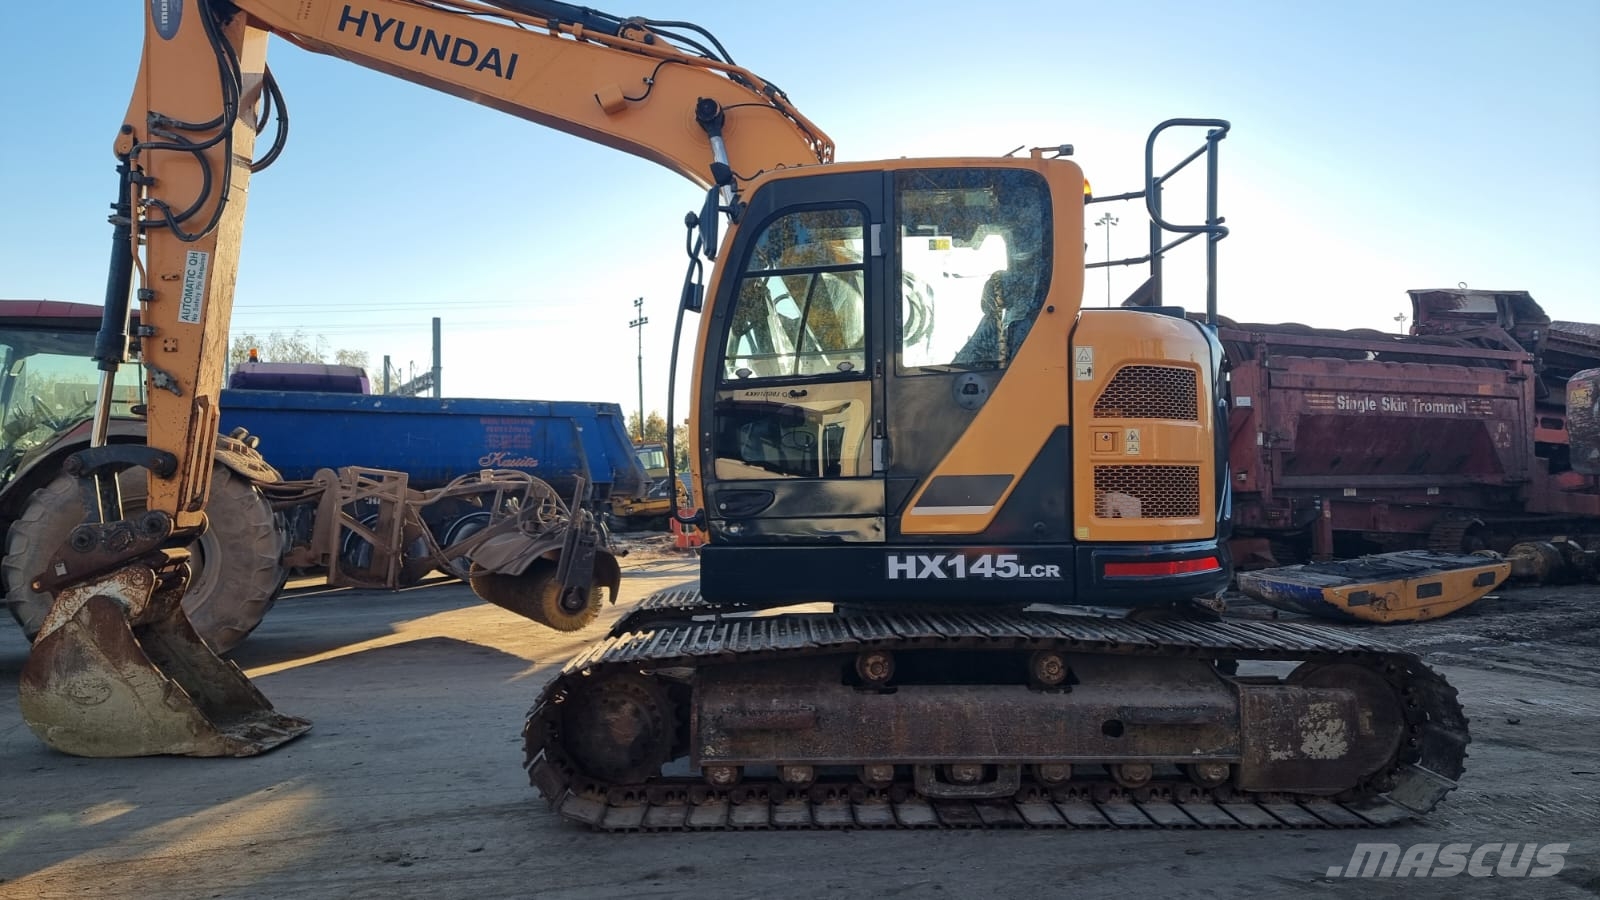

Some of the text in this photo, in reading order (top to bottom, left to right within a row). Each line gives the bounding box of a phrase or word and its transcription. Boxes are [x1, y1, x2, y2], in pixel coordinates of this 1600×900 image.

[337, 4, 519, 80] HYUNDAI
[198, 253, 206, 279] Required
[182, 252, 198, 320] AUTOMATIC QH
[193, 293, 202, 311] Safety
[192, 313, 198, 322] No
[1336, 395, 1467, 414] Single Skin Trommel
[887, 554, 1061, 579] HX145LCR
